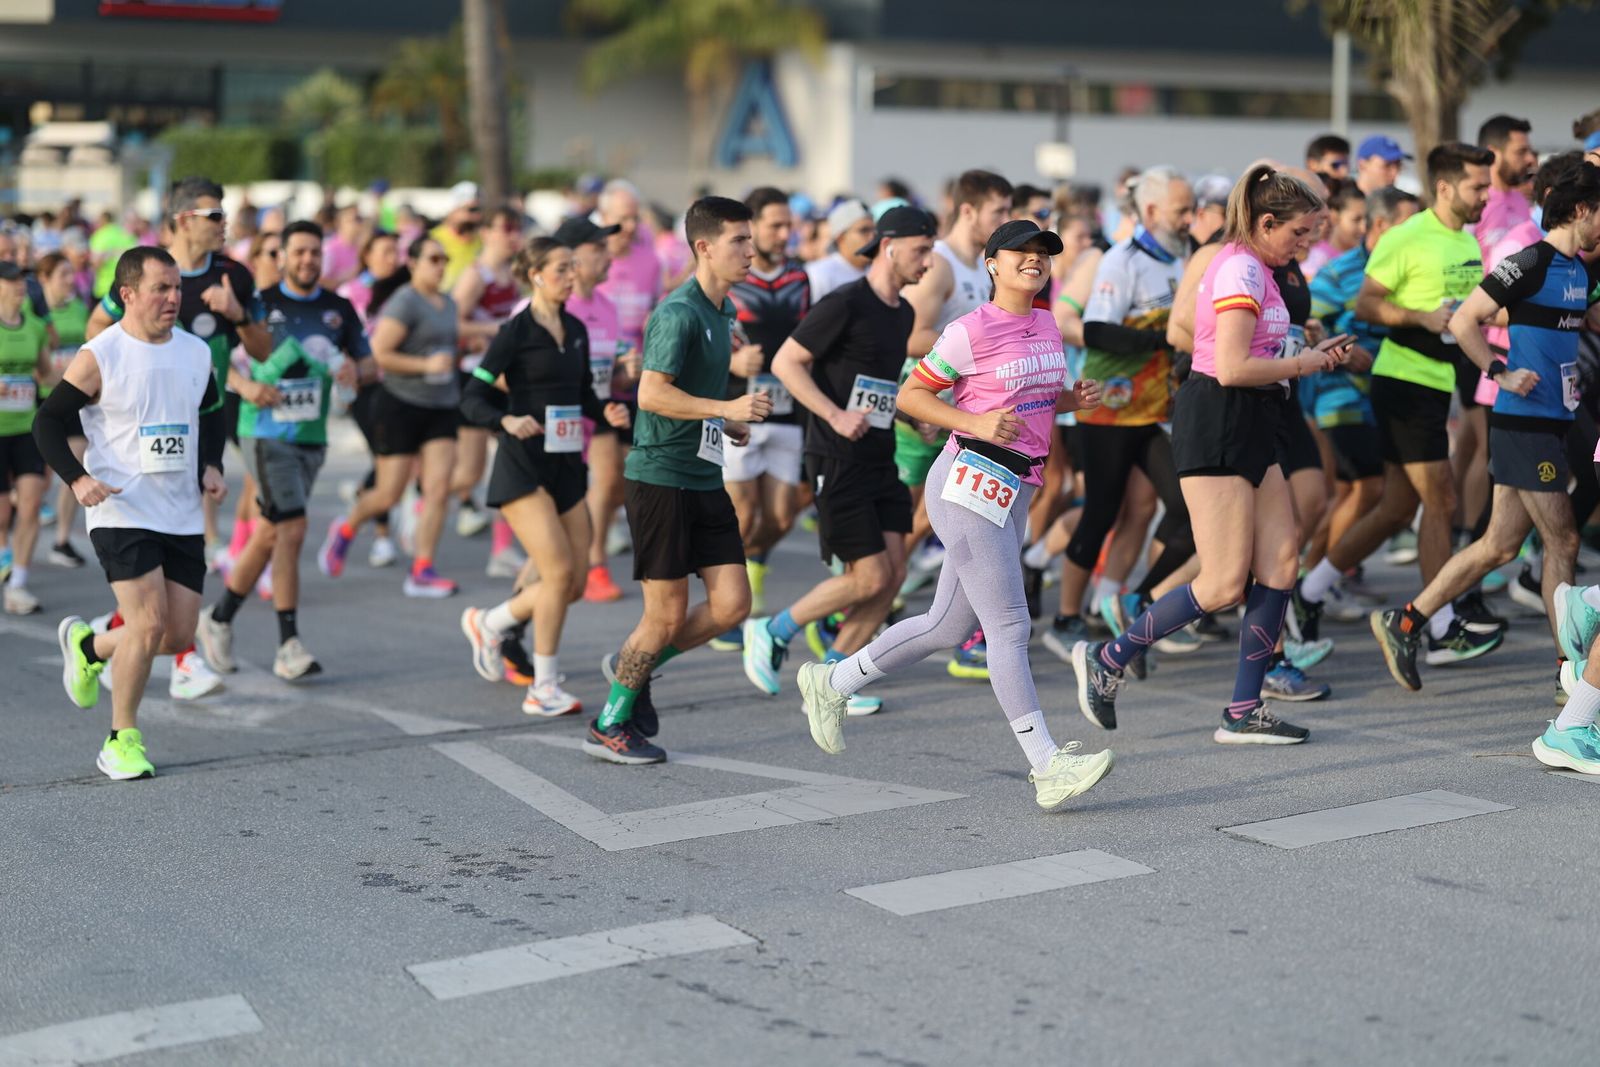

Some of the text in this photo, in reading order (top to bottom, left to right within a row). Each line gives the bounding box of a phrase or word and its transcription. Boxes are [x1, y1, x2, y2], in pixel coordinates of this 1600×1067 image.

[715, 57, 801, 169] A
[1027, 339, 1055, 354] XXXVI
[995, 355, 1039, 379] MEDIA
[856, 391, 894, 413] 1983
[150, 437, 184, 455] 429
[956, 466, 1013, 508] 1133
